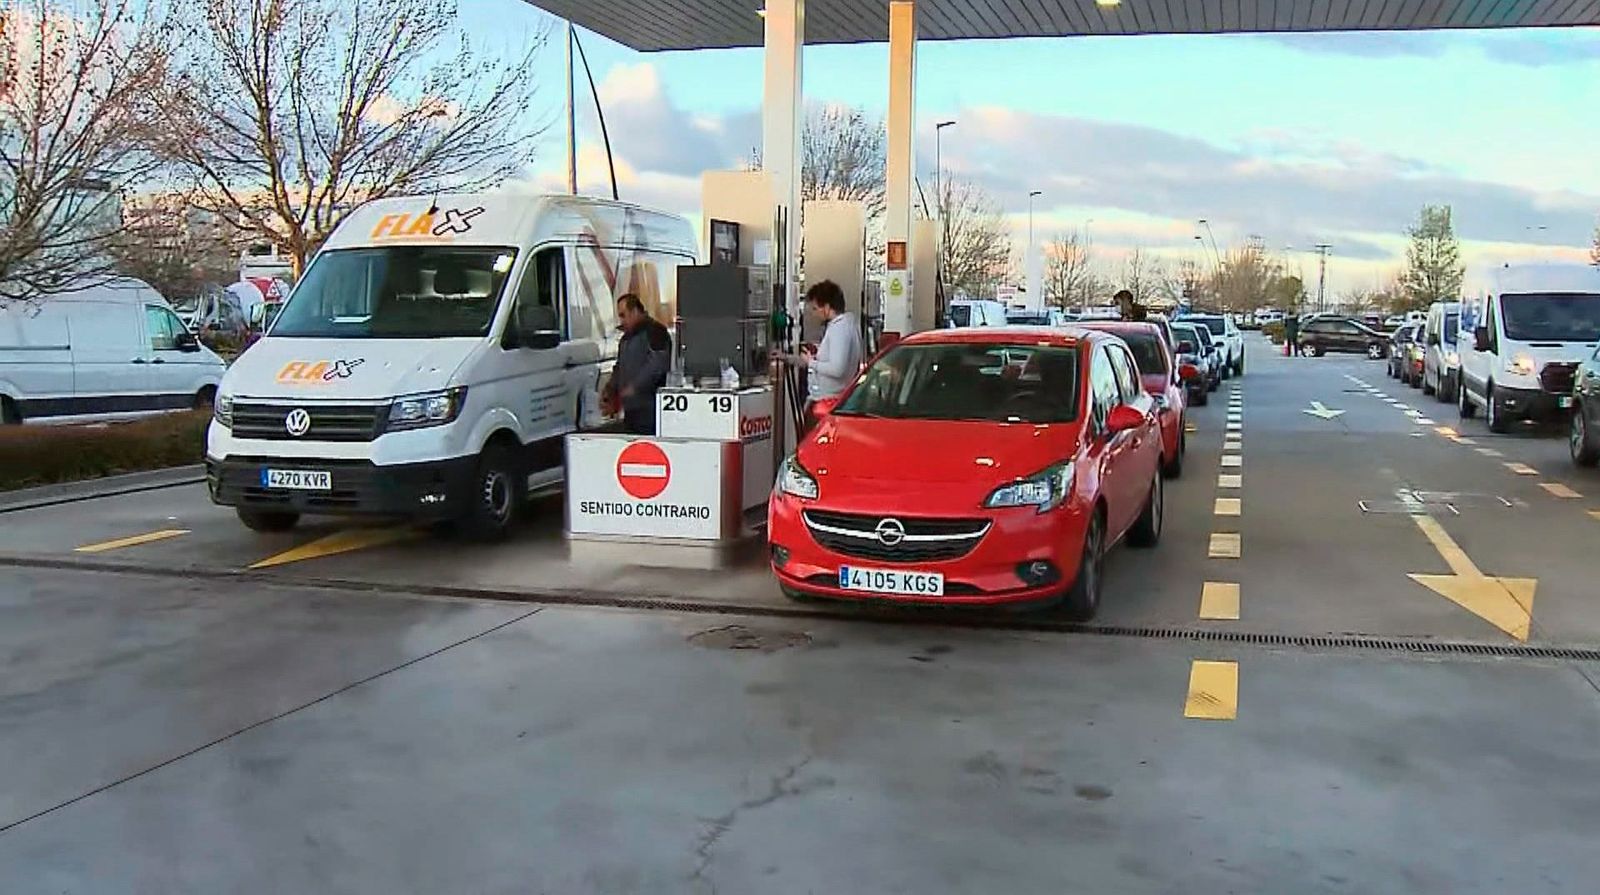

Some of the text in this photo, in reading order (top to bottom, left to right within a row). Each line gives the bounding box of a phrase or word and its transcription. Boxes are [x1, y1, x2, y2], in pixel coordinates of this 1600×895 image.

[371, 206, 485, 237] FLAX
[277, 358, 364, 382] FLAX
[662, 395, 688, 411] 20
[709, 396, 732, 412] 19
[271, 471, 328, 487] 4270 KVR
[580, 501, 710, 519] SENTIDO CONTRARIO
[852, 570, 938, 592] 4105 KGS
